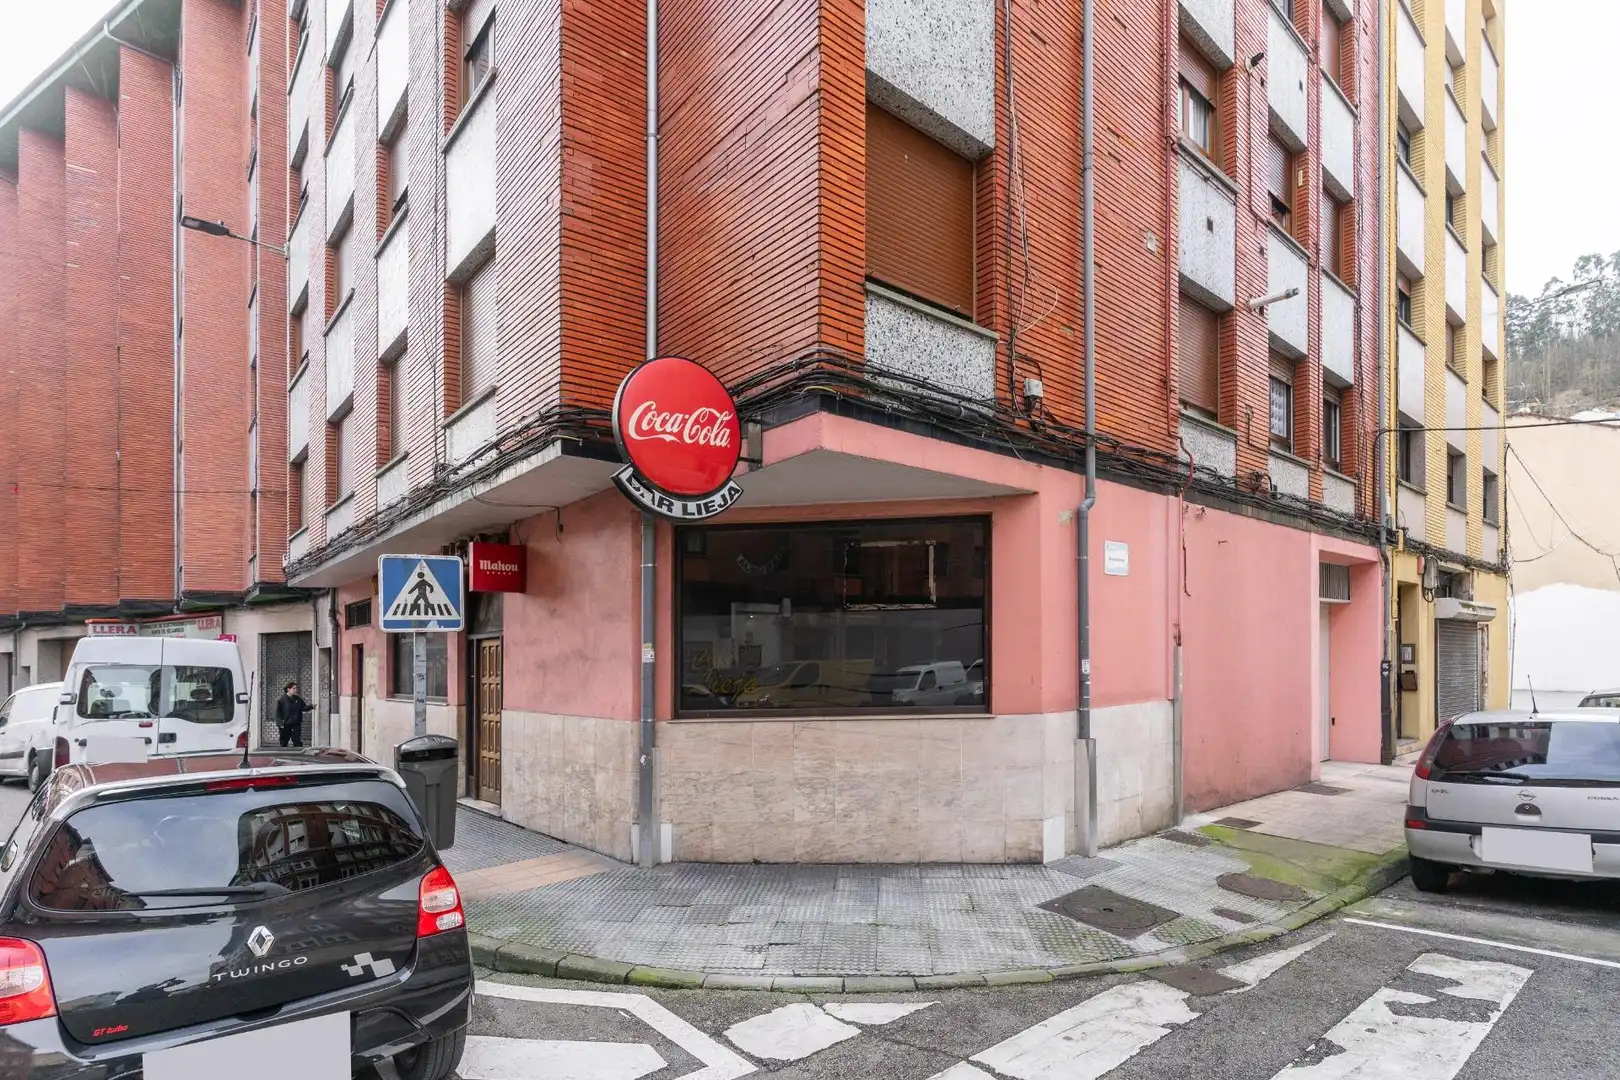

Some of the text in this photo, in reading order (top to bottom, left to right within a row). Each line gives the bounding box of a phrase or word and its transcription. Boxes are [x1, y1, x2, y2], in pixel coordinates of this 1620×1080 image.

[629, 401, 733, 447] Coca-Cola
[682, 485, 740, 516] LIEJA
[479, 559, 518, 571] Mahou
[93, 625, 136, 634] LLERA
[198, 618, 220, 630] LLERA
[212, 956, 308, 982] TWINGO
[92, 1024, 129, 1037] GT turbo
